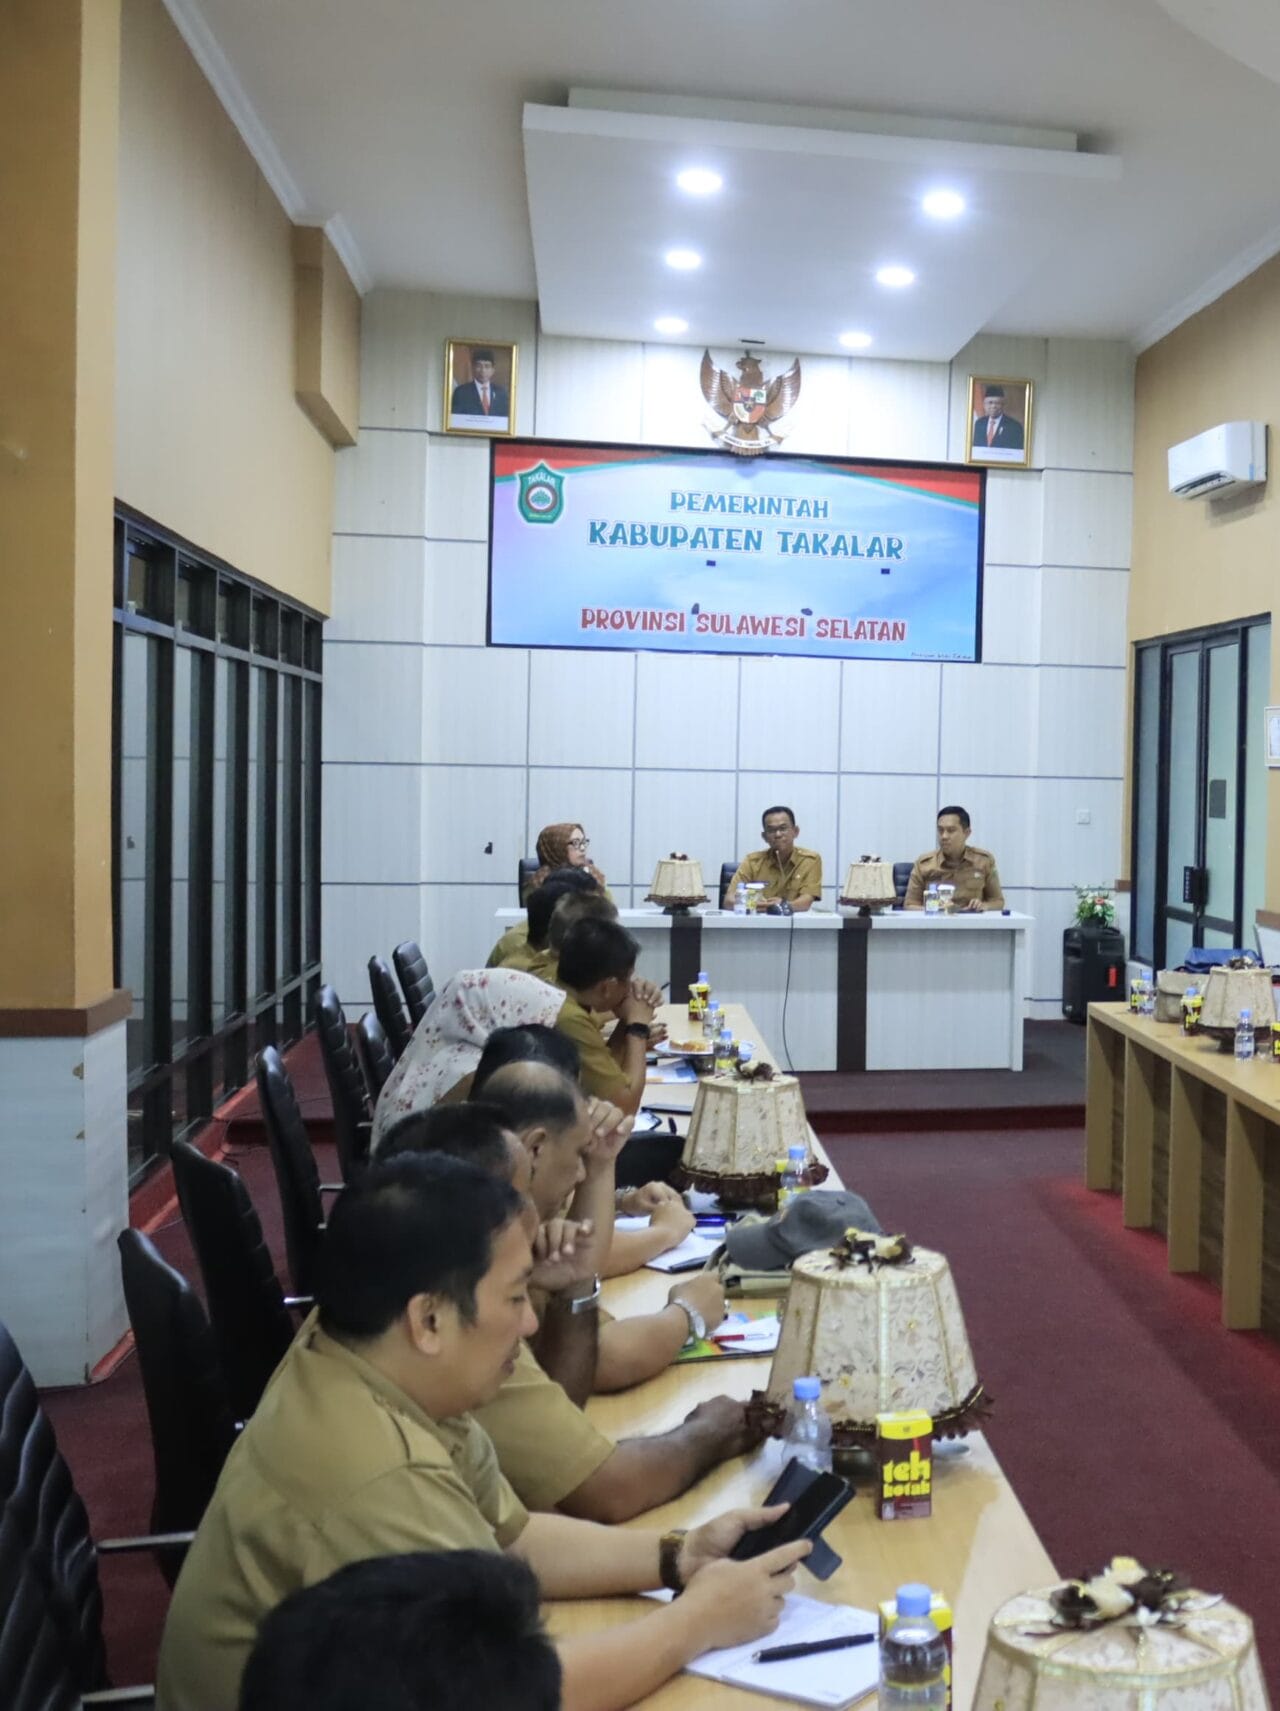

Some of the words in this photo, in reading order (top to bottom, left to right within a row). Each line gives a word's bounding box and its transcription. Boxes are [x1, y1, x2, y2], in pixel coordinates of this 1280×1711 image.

[670, 491, 829, 519] PEMERINTAH
[588, 520, 764, 551] KABUPATEN
[776, 530, 905, 560] TAKALAR
[580, 607, 685, 631] PROVINSI
[695, 612, 806, 637] SULAWESI
[815, 618, 906, 641] SELATAN
[882, 1450, 931, 1483] teh
[882, 1480, 931, 1499] kotak
